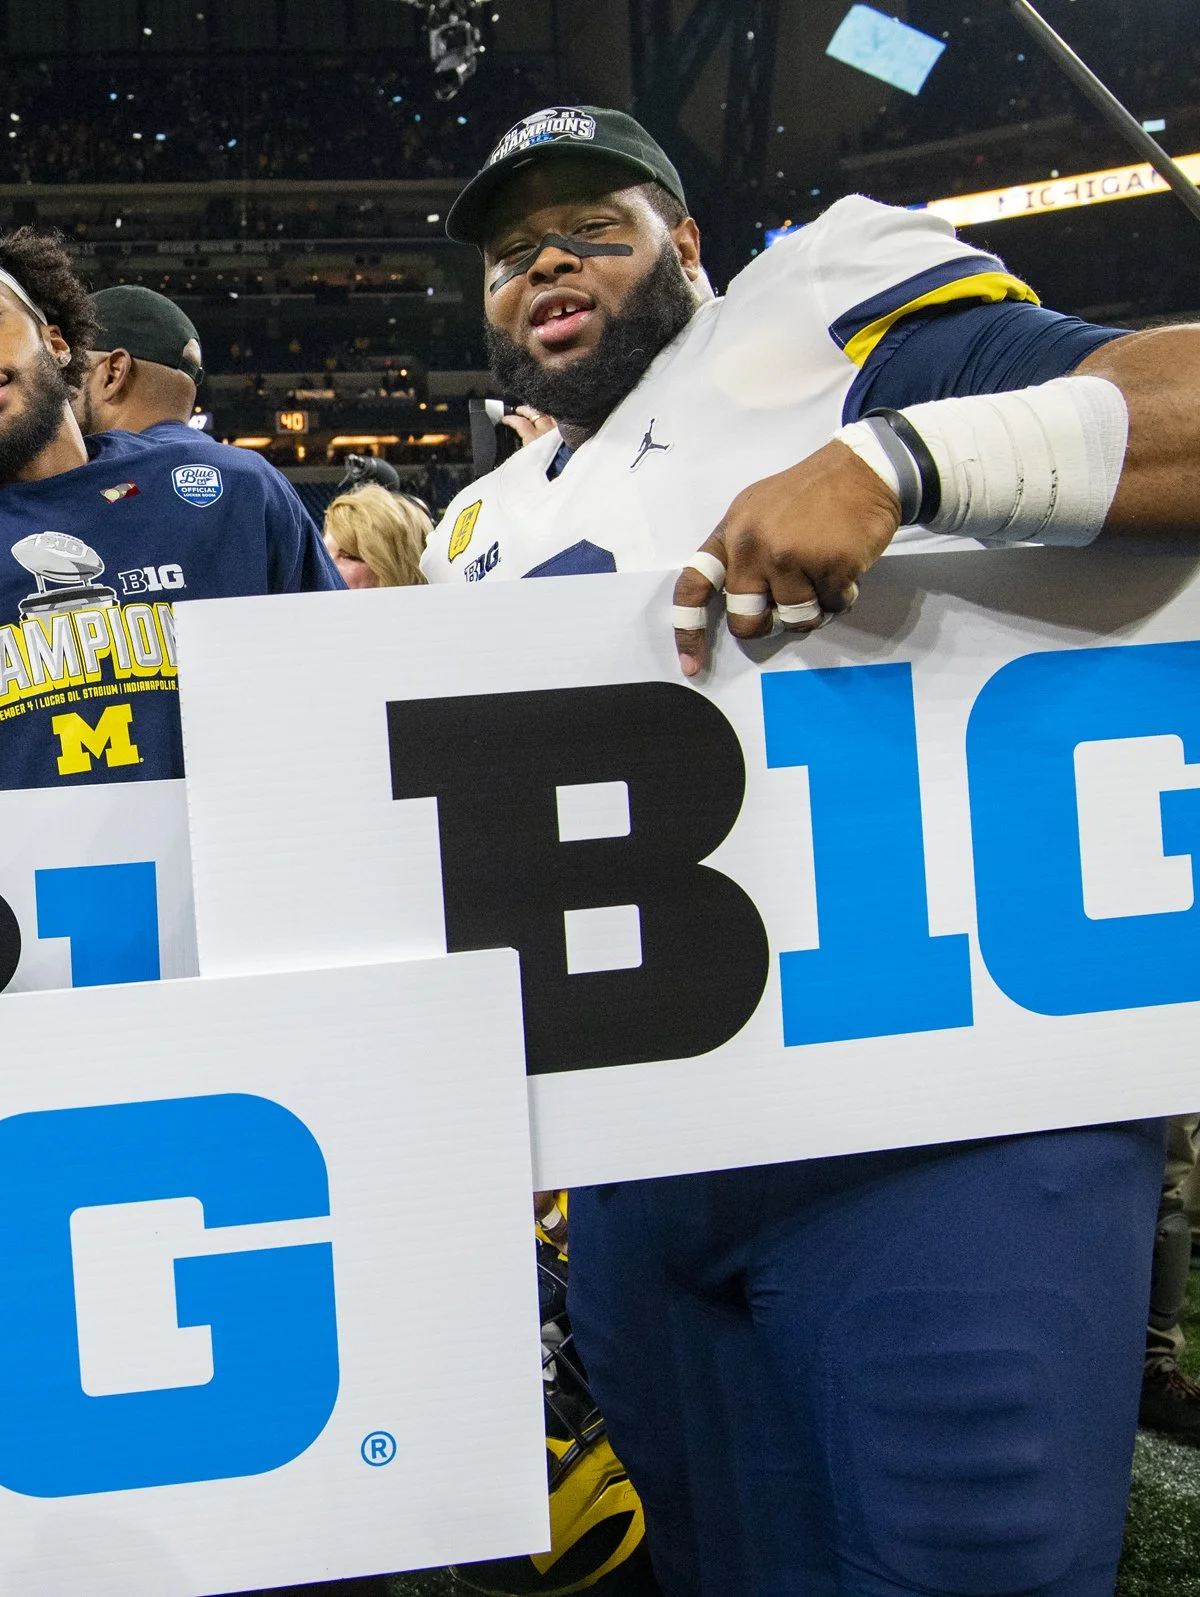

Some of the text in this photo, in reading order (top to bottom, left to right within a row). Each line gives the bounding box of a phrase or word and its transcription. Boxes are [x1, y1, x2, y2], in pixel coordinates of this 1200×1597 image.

[998, 169, 1160, 213] ICHIGA
[281, 412, 304, 430] 40
[180, 469, 214, 484] Blue
[27, 702, 34, 713] 4
[40, 693, 66, 709] LUCAS
[67, 691, 81, 703] OIL
[83, 685, 119, 700] STADIUM
[51, 703, 144, 776] M
